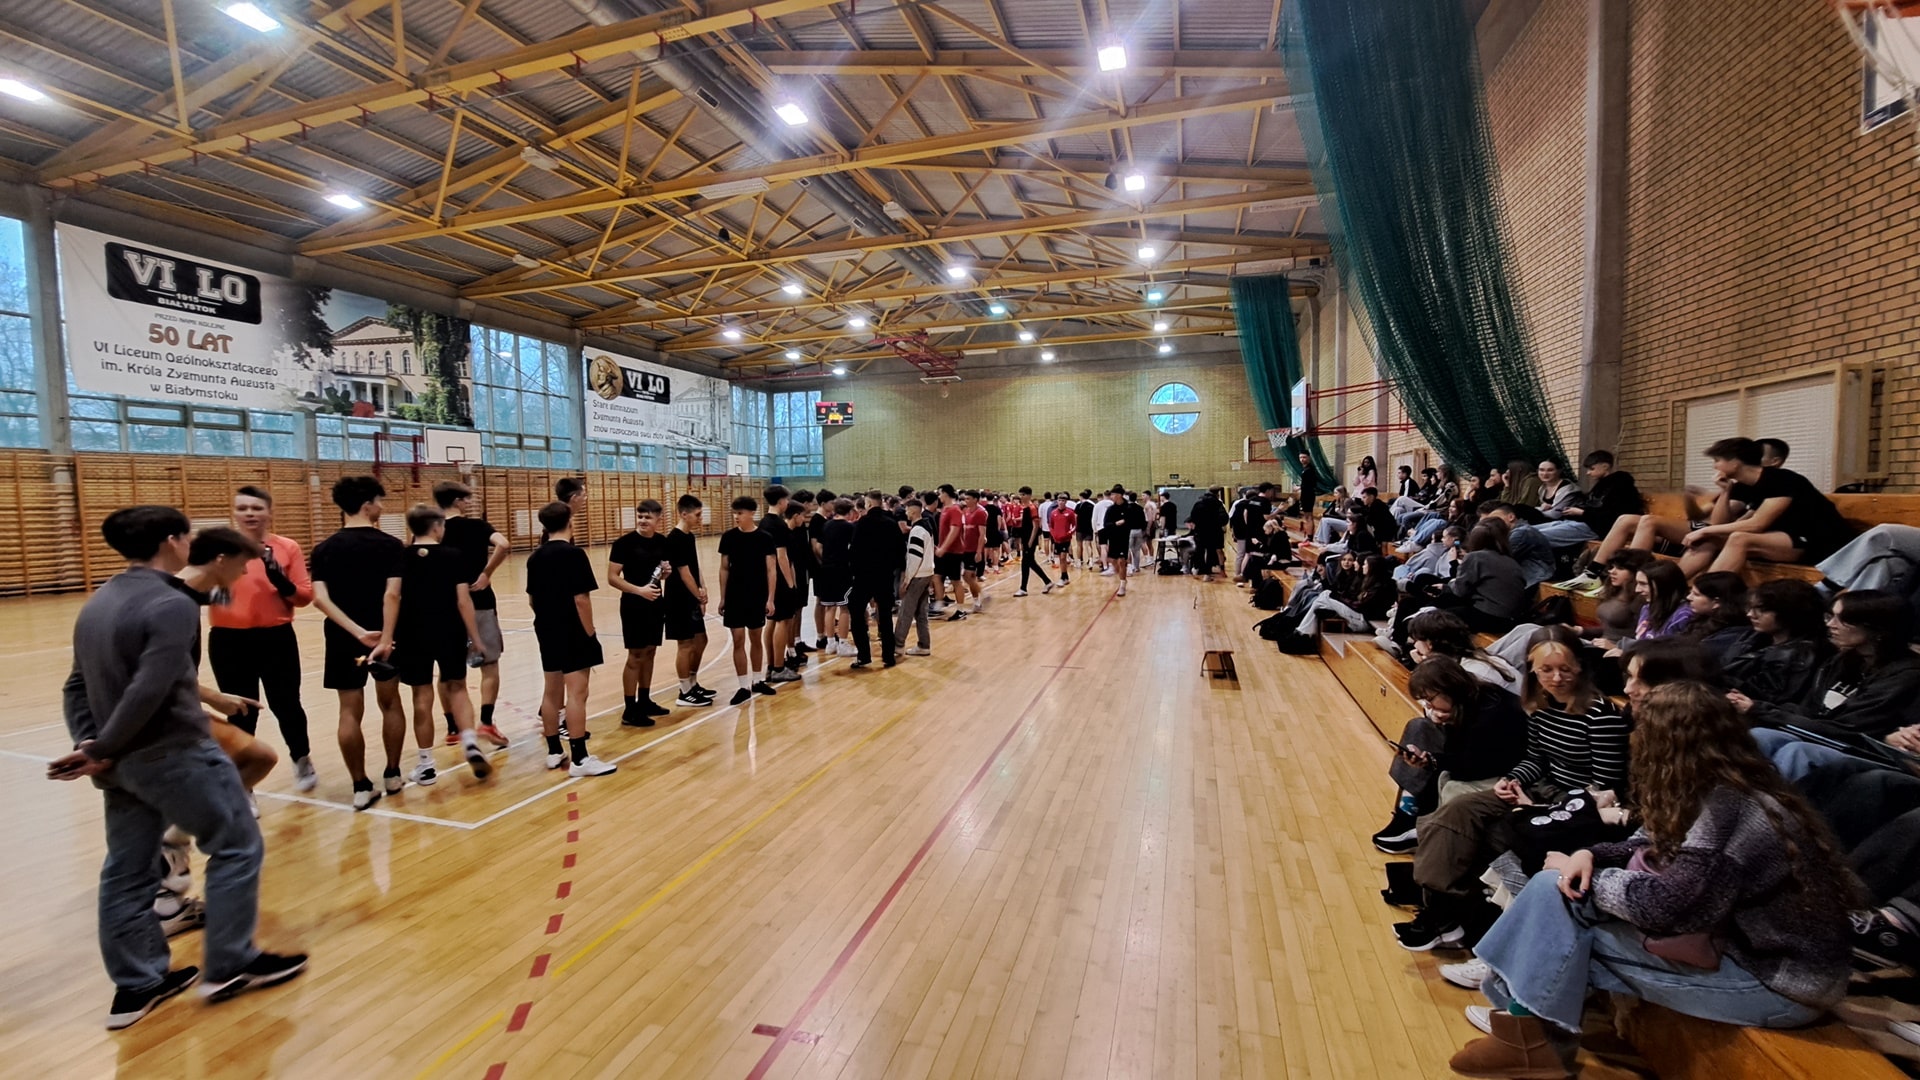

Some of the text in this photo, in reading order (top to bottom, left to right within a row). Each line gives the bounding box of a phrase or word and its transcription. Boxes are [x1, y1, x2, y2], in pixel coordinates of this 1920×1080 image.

[123, 250, 247, 305] VI LO
[158, 297, 216, 314] BIAŁYSTOK
[176, 293, 199, 303] 1915
[149, 323, 233, 354] 50 LAT
[114, 344, 162, 360] Liceum
[165, 352, 278, 376] Ogólnokształcącego
[101, 358, 275, 390] im. Króla Zygmunta Augusta
[626, 370, 665, 394] VI LO
[150, 383, 238, 401] w Białymstoku
